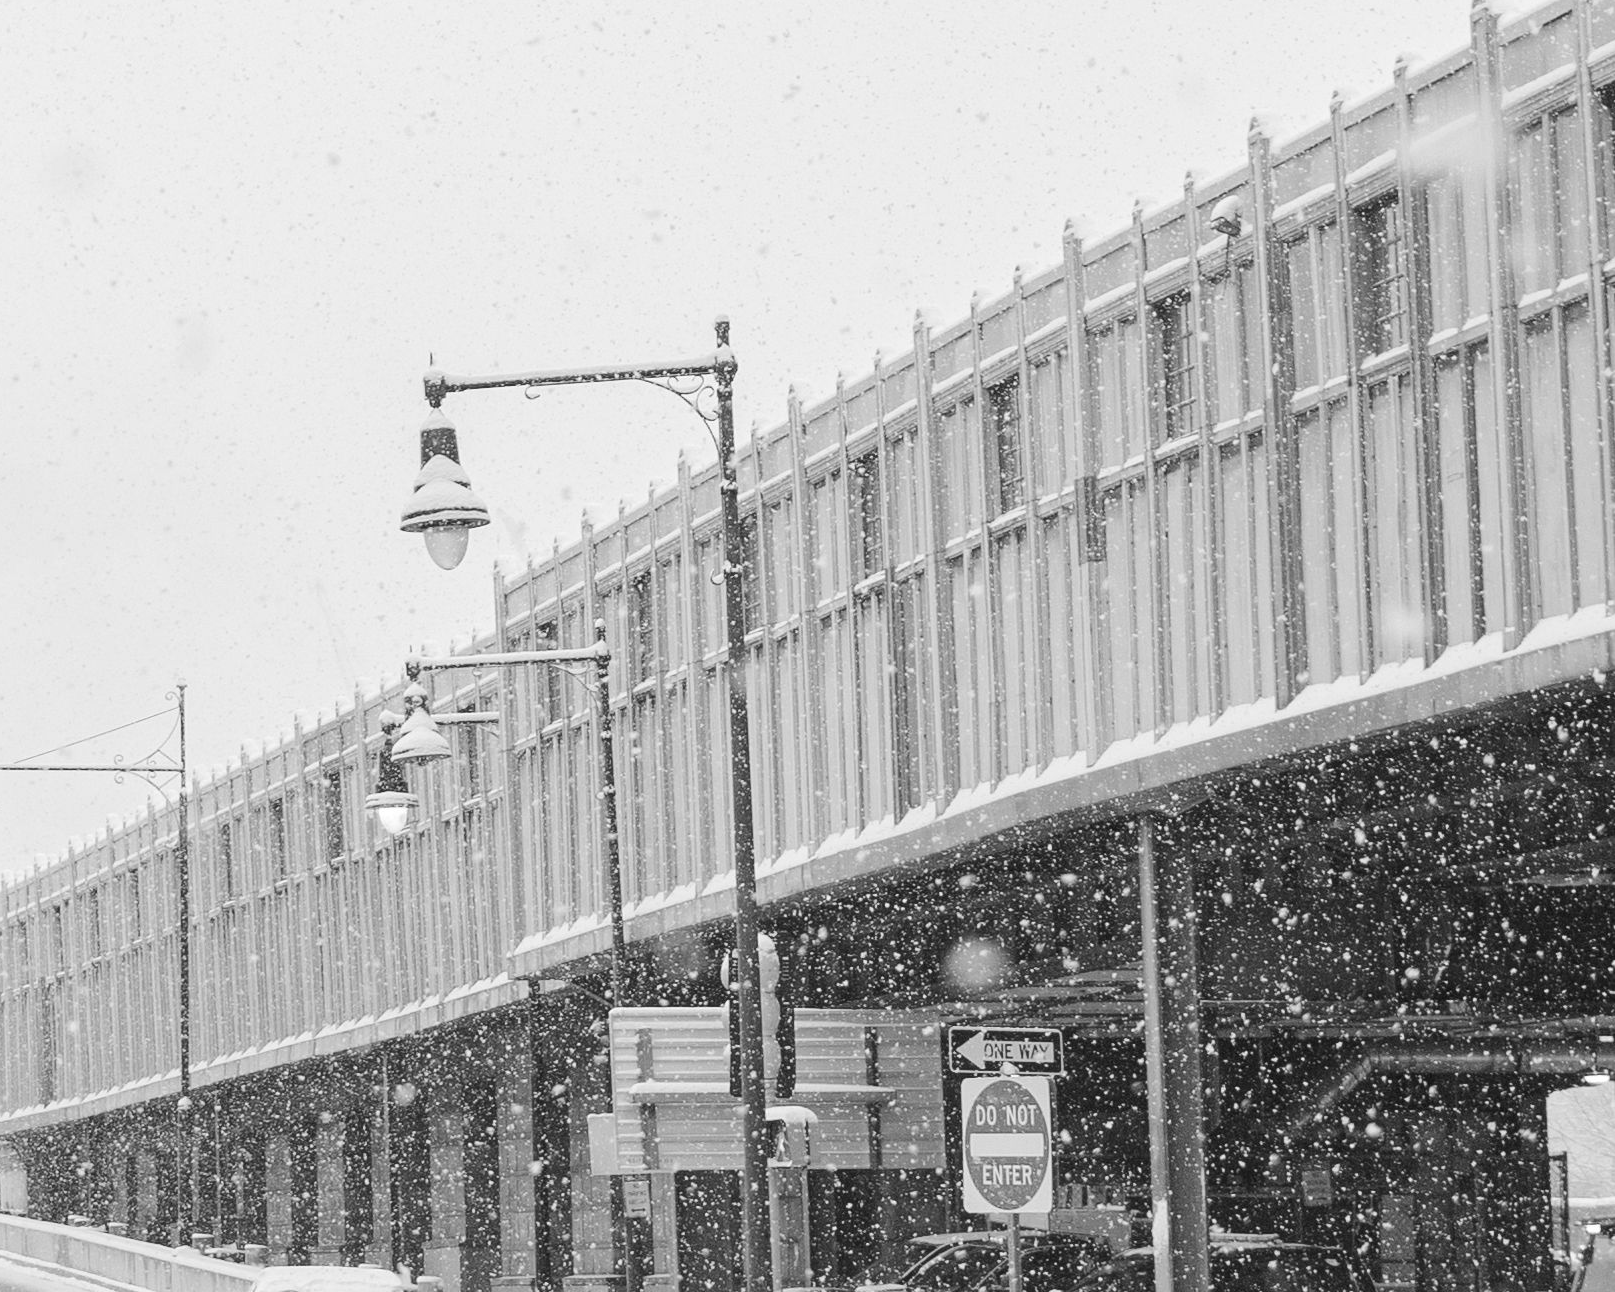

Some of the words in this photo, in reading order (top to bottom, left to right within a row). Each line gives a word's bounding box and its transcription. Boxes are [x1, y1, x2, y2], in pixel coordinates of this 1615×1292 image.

[984, 1043, 1013, 1059] ONE
[1018, 1044, 1050, 1060] WAY
[975, 1104, 997, 1126] DO
[1006, 1104, 1037, 1127] NOT
[982, 1164, 1033, 1186] ENTER
